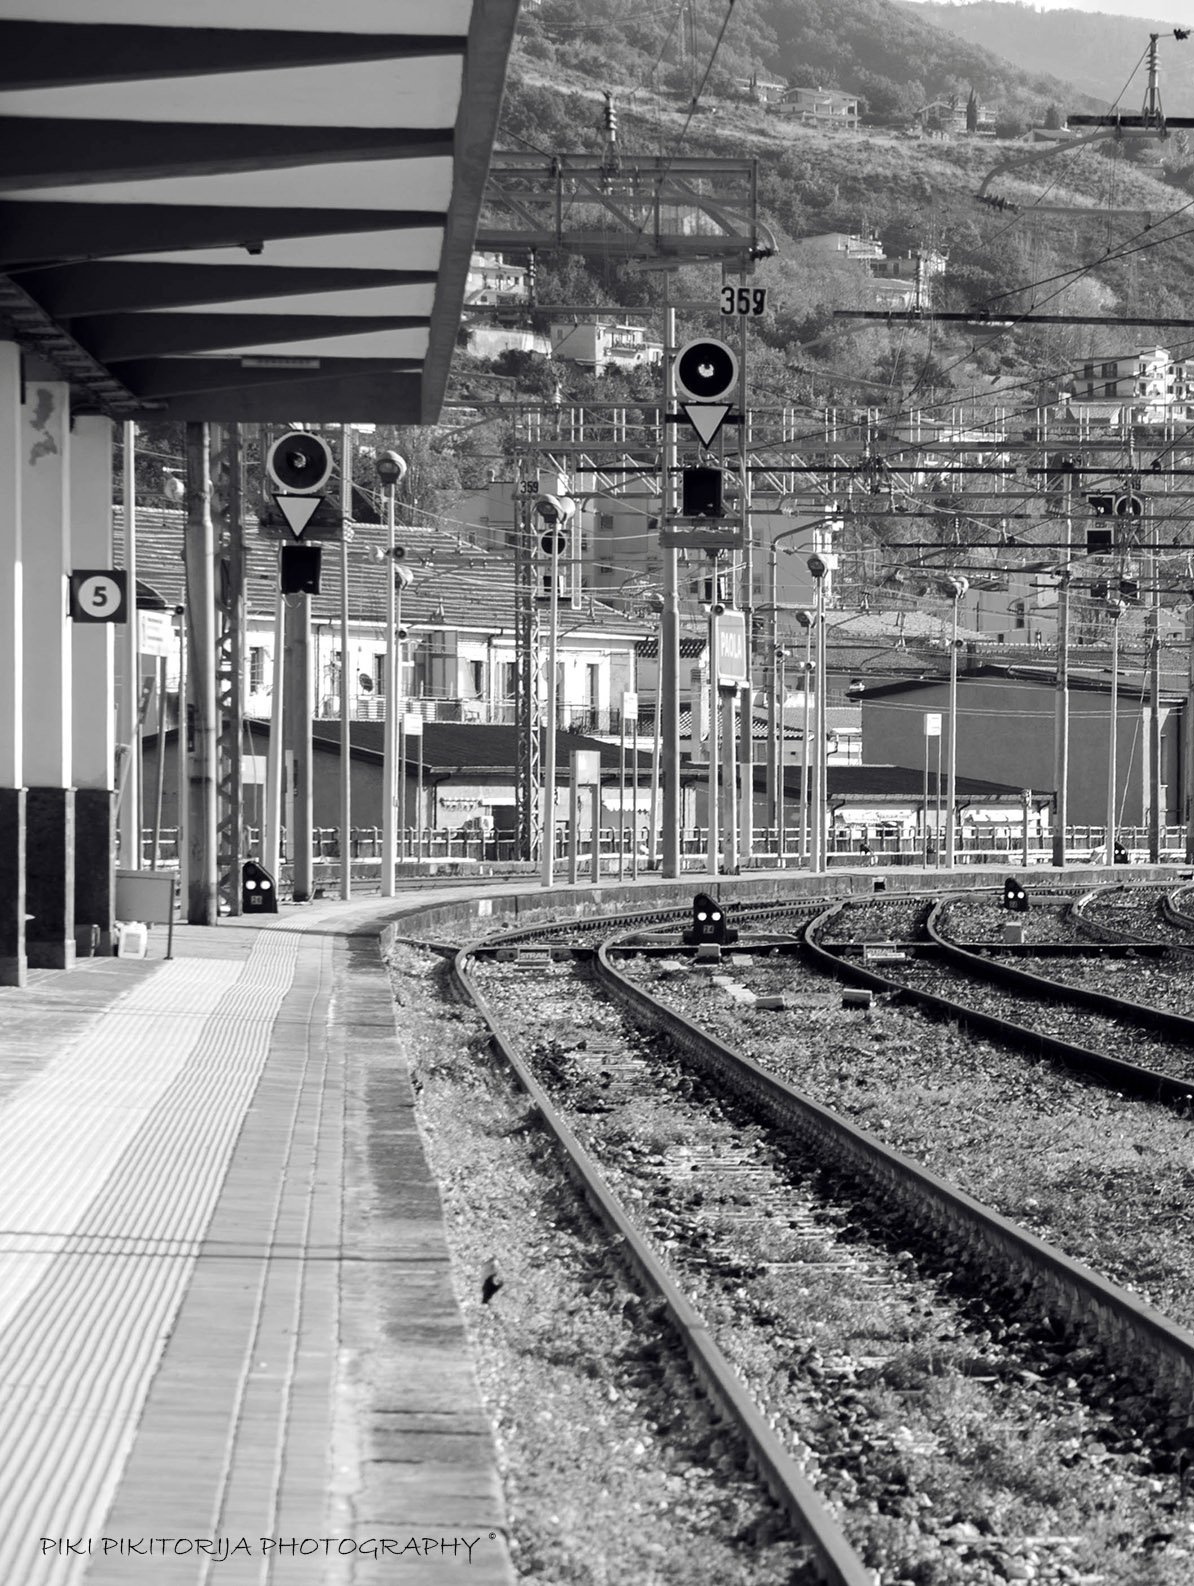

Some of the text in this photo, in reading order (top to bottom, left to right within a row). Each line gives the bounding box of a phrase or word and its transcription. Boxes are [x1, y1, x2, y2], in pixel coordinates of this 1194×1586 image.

[721, 287, 766, 315] 359
[520, 481, 538, 493] 359
[92, 586, 107, 607] 5
[720, 631, 742, 658] PAOLA
